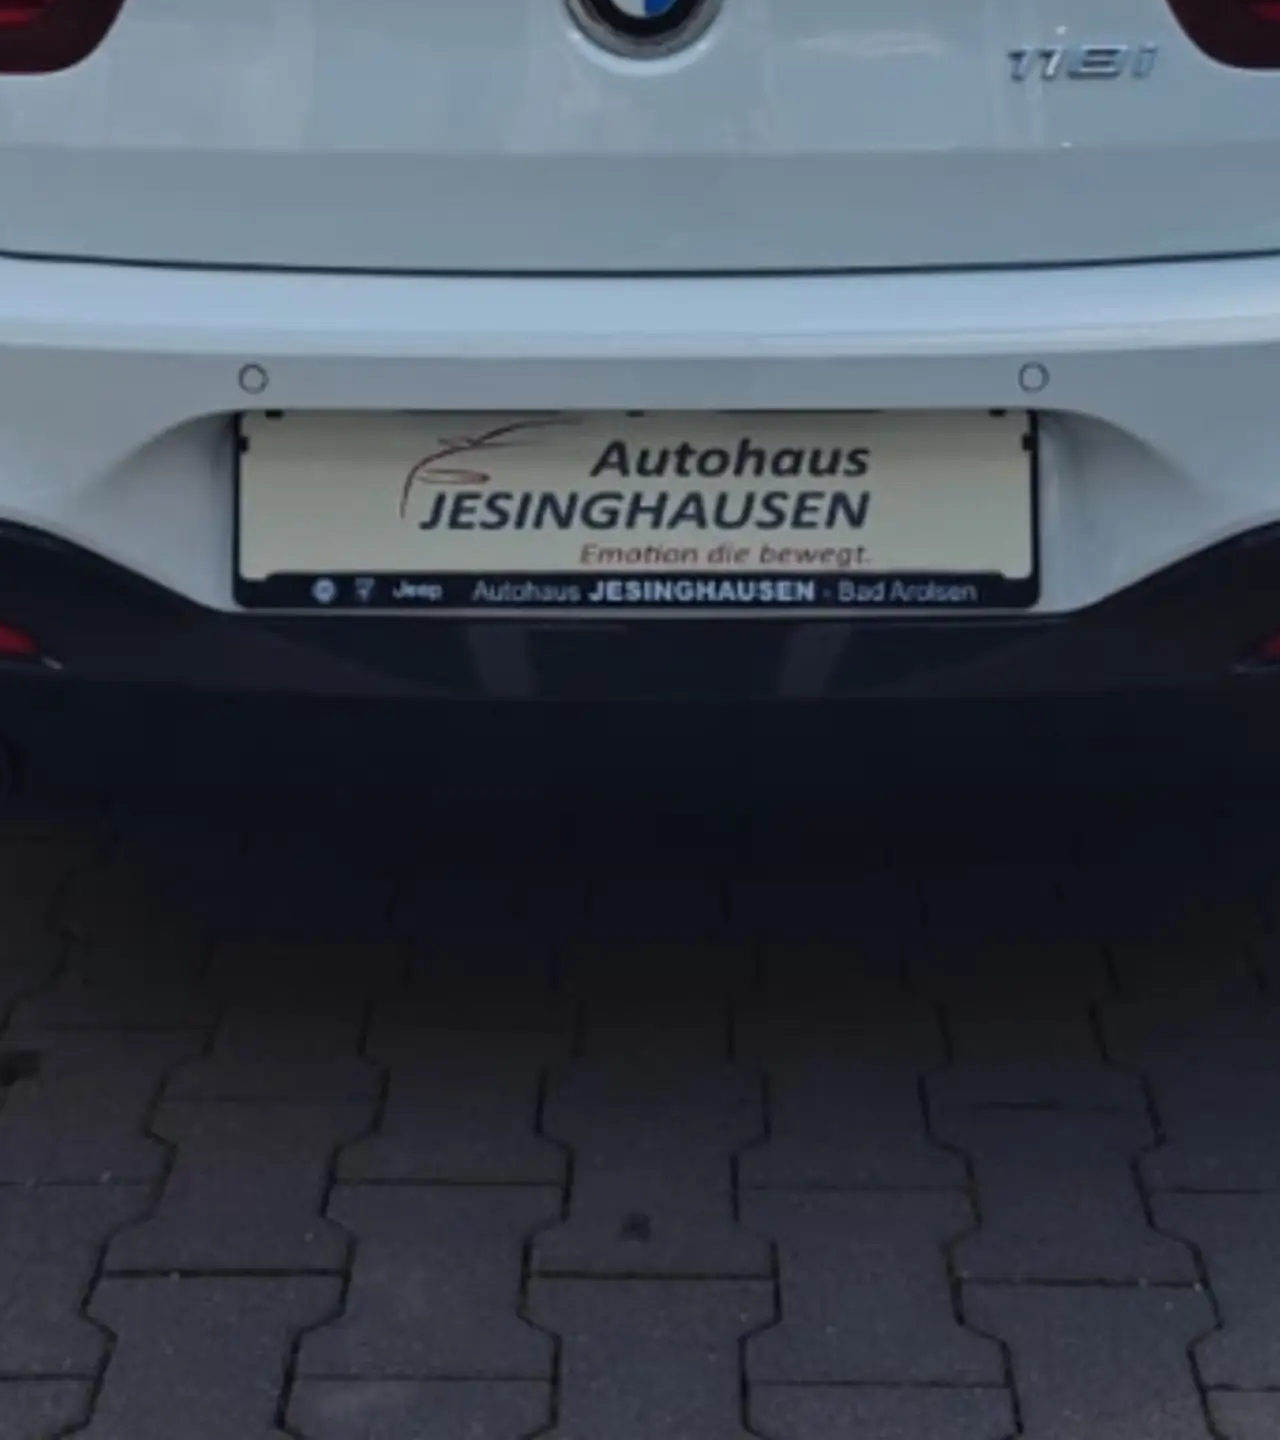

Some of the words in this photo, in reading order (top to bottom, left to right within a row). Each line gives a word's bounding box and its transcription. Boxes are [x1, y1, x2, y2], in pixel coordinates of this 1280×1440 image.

[590, 438, 871, 478] Autohaus
[419, 491, 871, 531] JESINGHAUSEN
[580, 543, 698, 566] Emotion
[706, 542, 751, 566] die
[471, 580, 580, 602] Autohaus
[588, 580, 816, 602] JESINGHAUSEN
[837, 580, 885, 602] Bad
[888, 580, 978, 602] Arolsen
